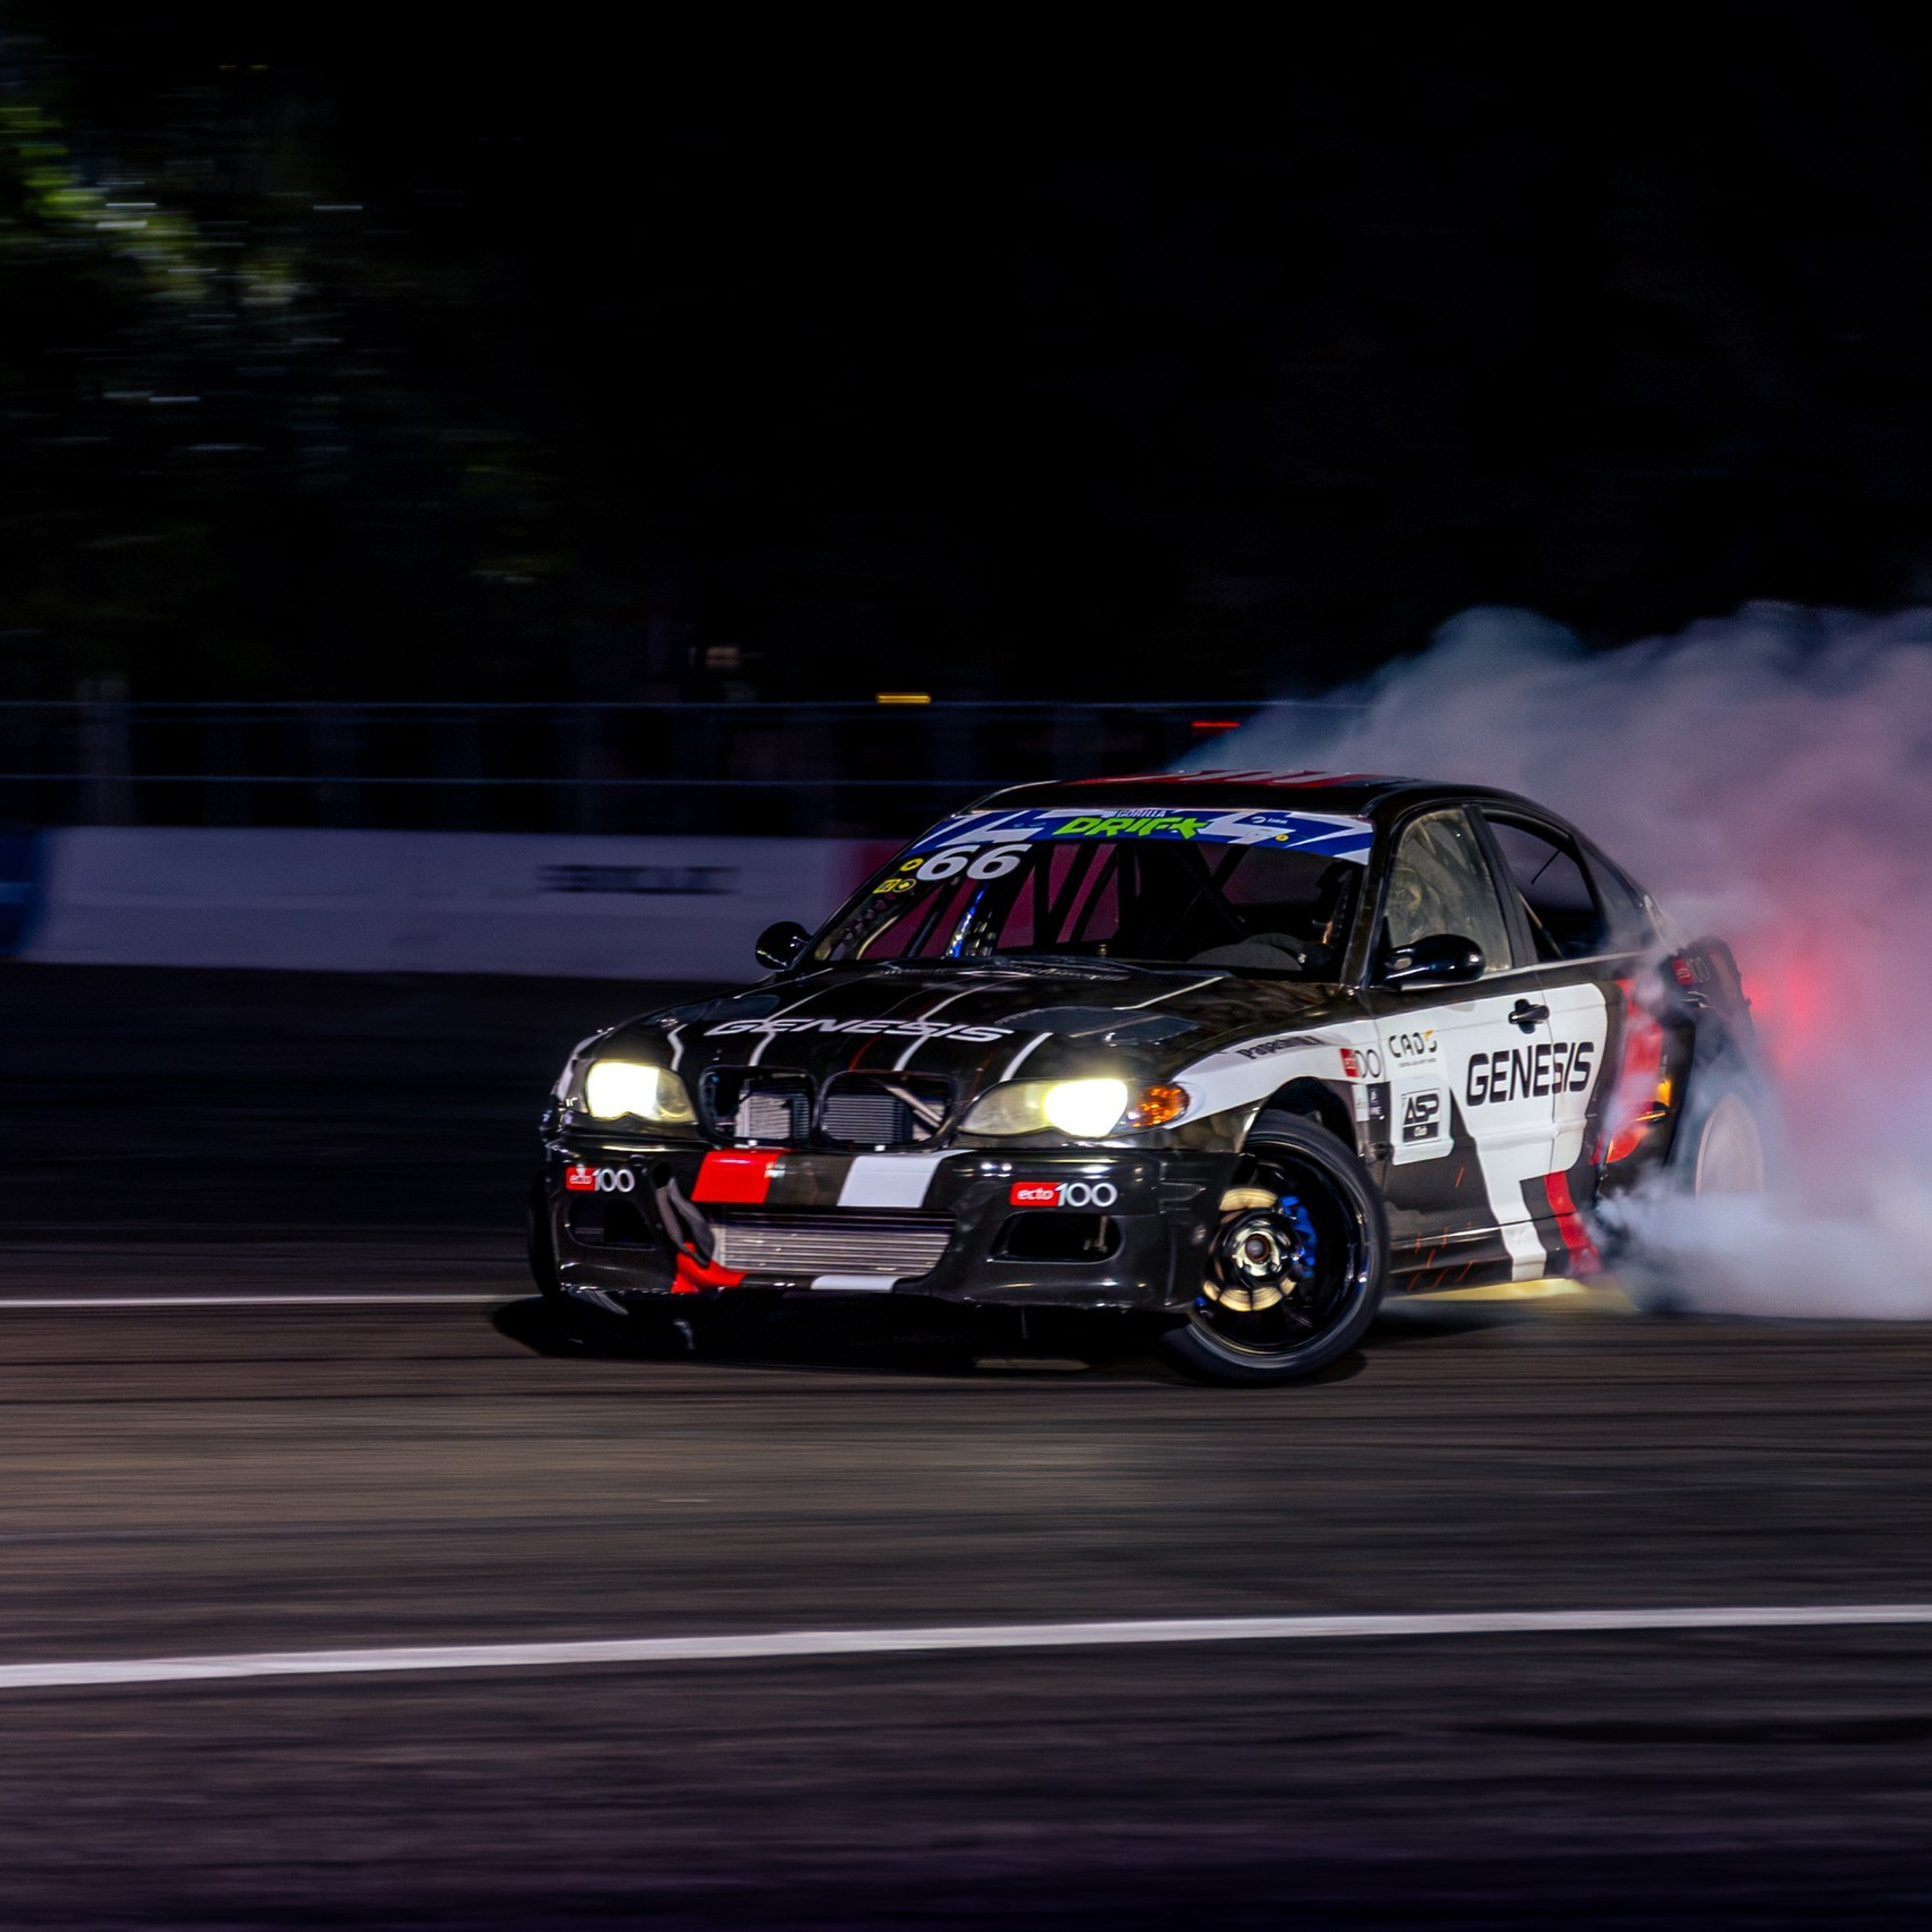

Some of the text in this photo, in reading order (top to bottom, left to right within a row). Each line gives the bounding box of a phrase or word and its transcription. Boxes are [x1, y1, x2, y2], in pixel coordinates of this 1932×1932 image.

[916, 844, 1033, 881] 66
[703, 1019, 1014, 1042] GENESIS
[1466, 1041, 1595, 1106] GENESIS
[1402, 1094, 1440, 1125] ASP
